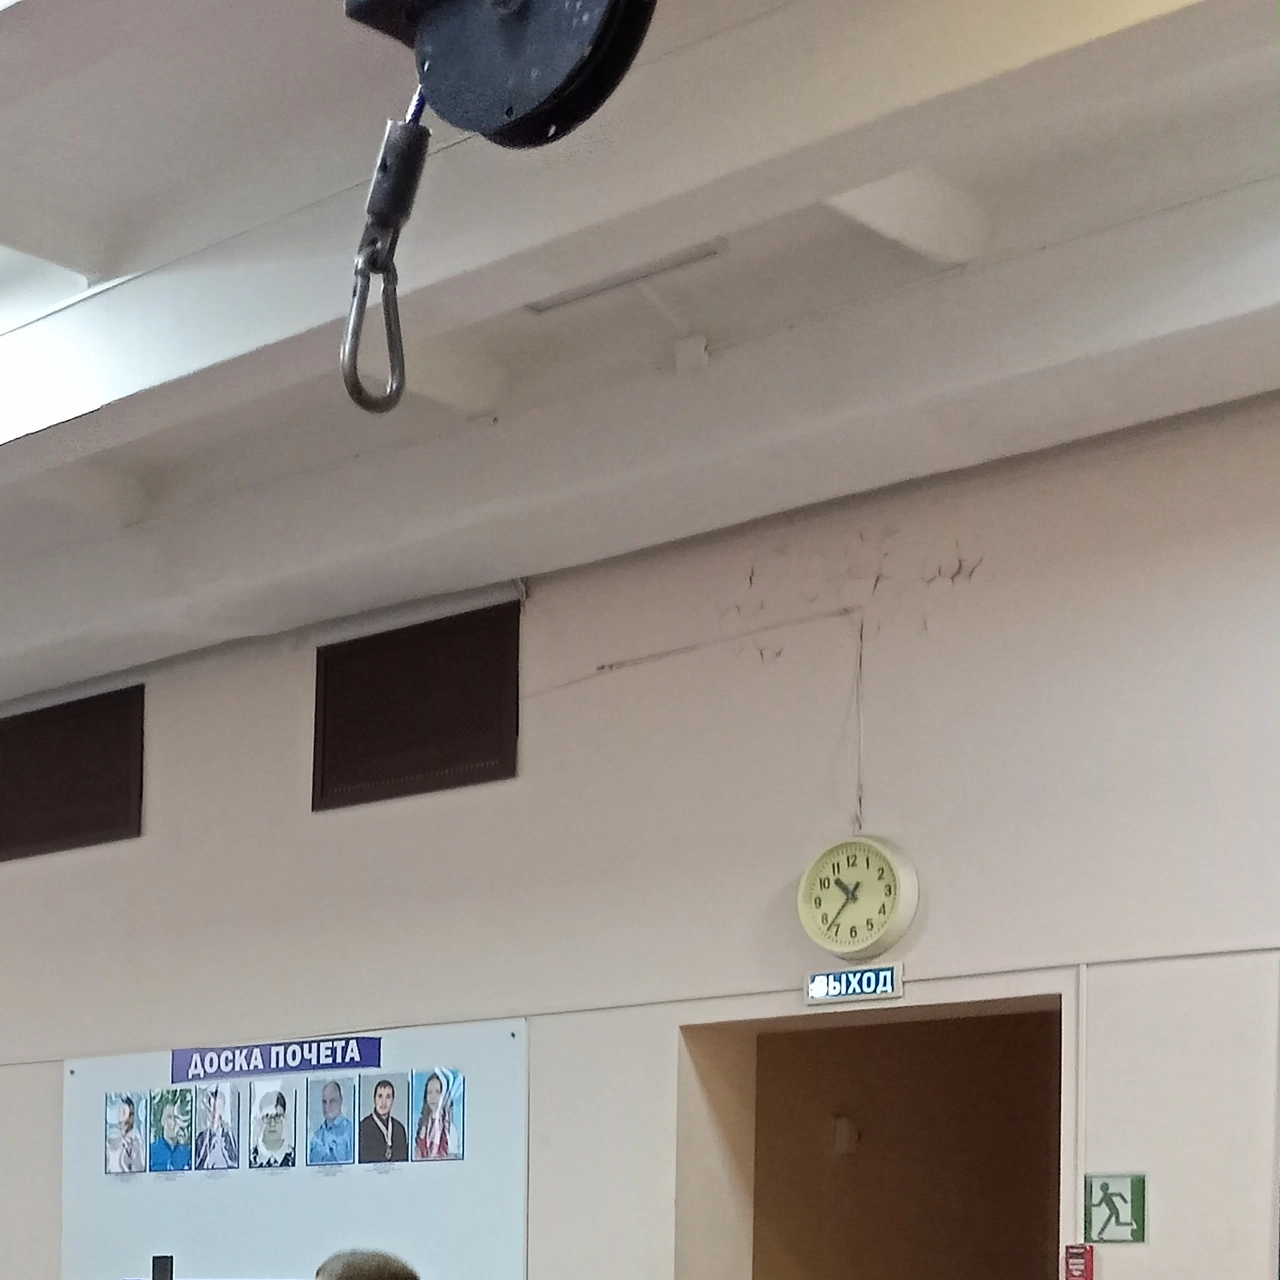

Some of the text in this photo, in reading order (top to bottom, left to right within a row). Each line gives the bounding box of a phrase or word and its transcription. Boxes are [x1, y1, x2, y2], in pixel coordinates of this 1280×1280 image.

[846, 855, 858, 867] 12
[866, 857, 870, 869] 1
[832, 863, 840, 875] 11
[878, 868, 884, 880] 2
[819, 878, 830, 890] 10
[884, 885, 892, 897] 3
[814, 897, 822, 908] 9
[878, 903, 886, 915] 4
[822, 913, 828, 925] 8
[866, 919, 873, 931] 5
[833, 924, 840, 937] 7
[850, 926, 857, 938] 6
[188, 1040, 360, 1079] ДОСКА ПОЧЕТА
